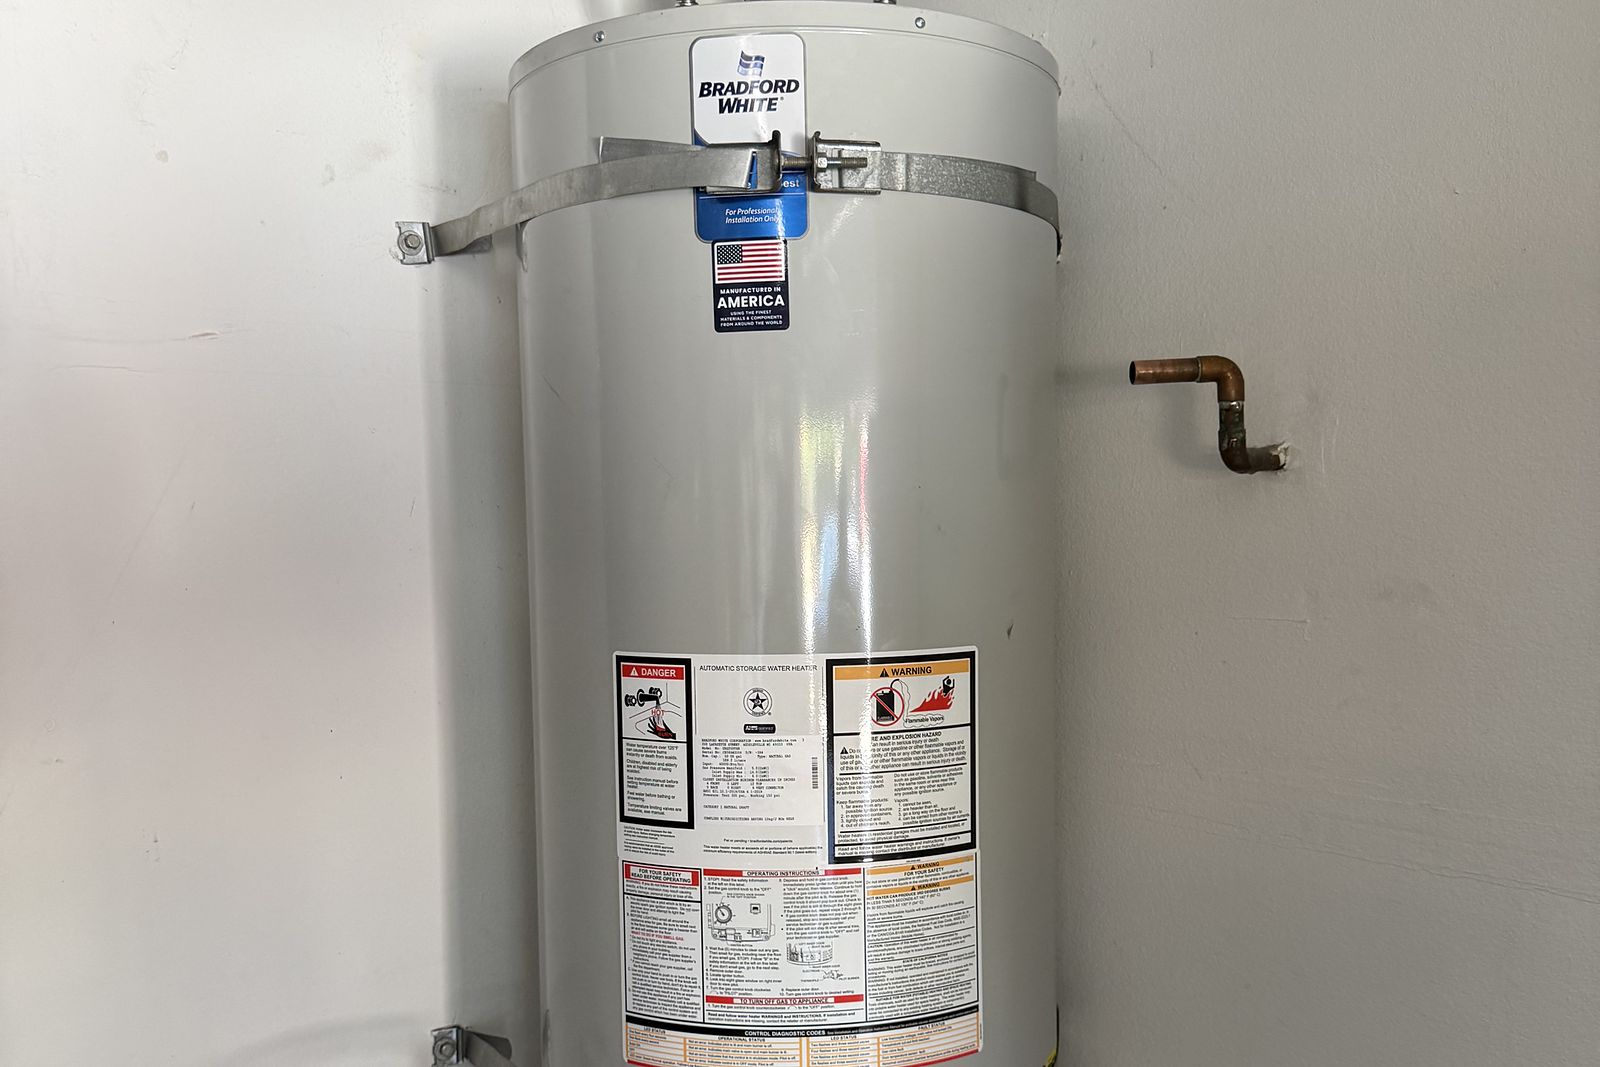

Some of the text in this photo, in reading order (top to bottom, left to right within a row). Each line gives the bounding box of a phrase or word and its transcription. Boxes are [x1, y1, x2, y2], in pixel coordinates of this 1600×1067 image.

[699, 80, 800, 98] BRADFORD
[718, 97, 778, 114] WHITE
[782, 180, 800, 188] est
[726, 216, 762, 224] Installation
[718, 295, 785, 308] AMERICA
[641, 668, 676, 677] DANGER
[891, 667, 932, 676] WARNING
